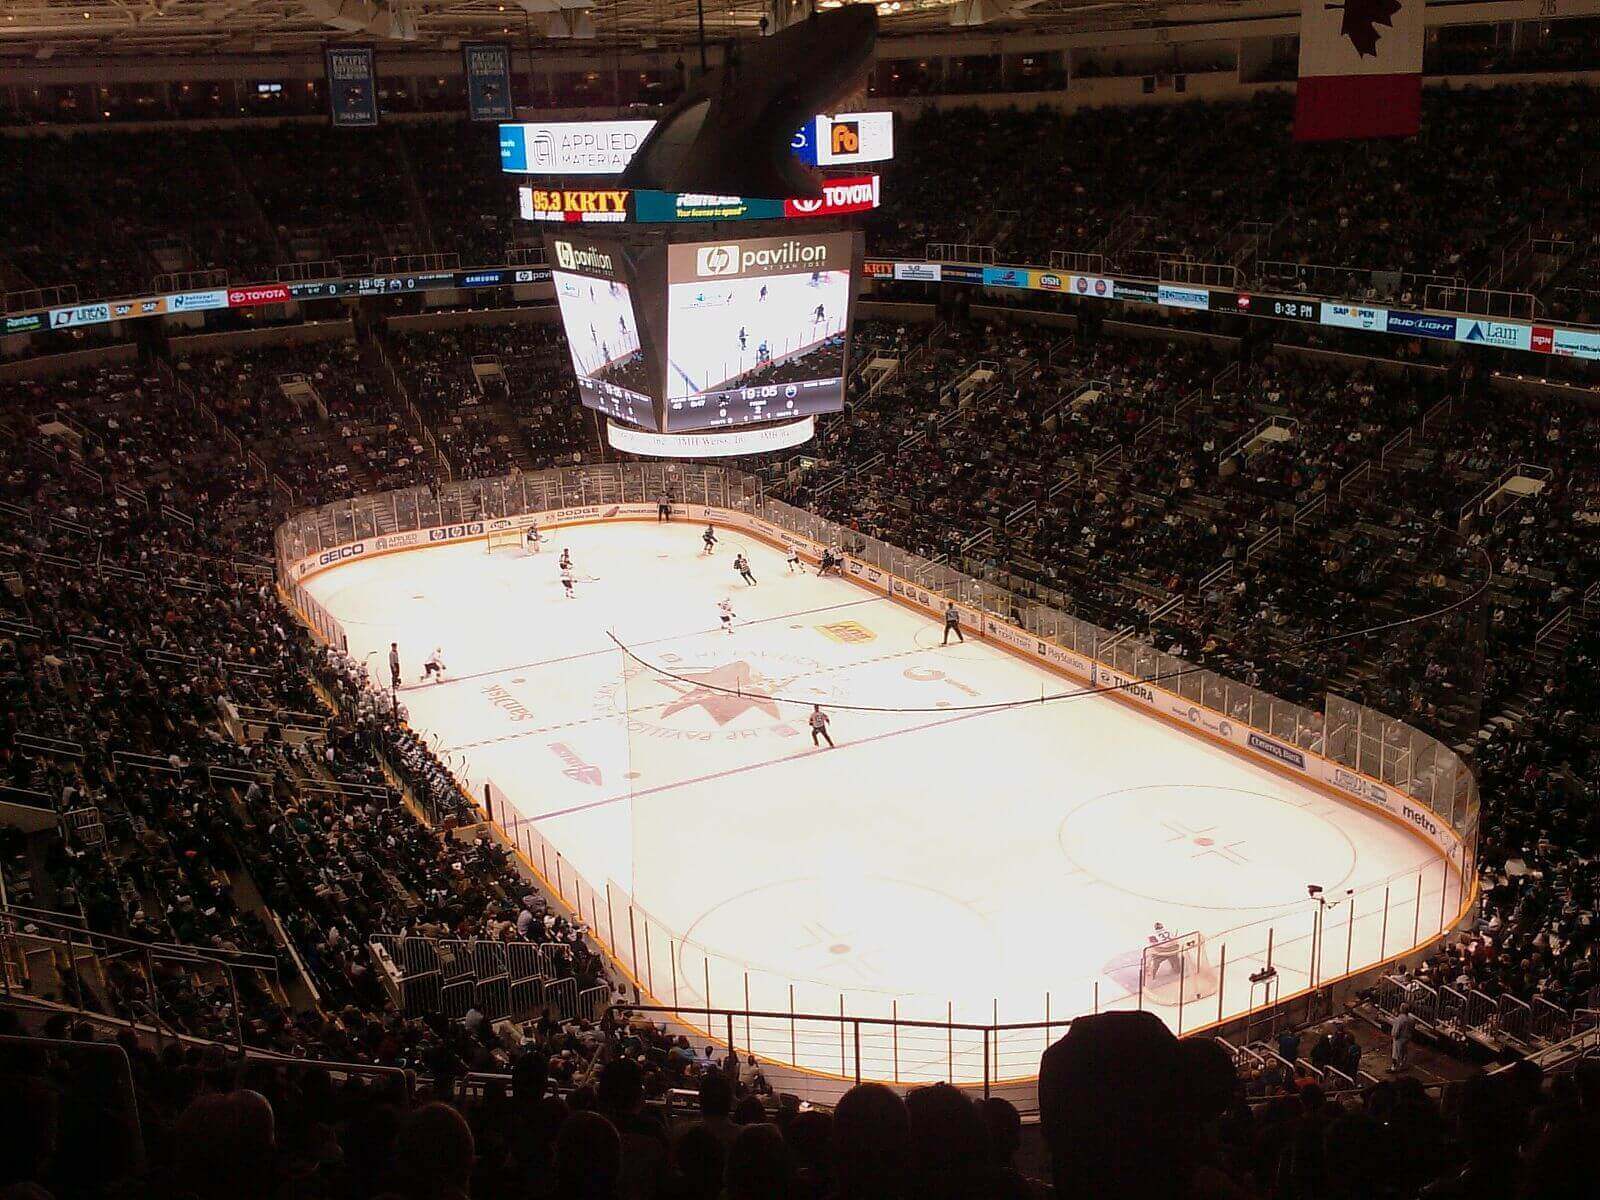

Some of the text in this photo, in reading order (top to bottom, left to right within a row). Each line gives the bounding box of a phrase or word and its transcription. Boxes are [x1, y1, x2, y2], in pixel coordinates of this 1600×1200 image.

[333, 55, 367, 65] PACIFIC
[561, 133, 638, 150] APPLIED
[533, 190, 629, 212] 95.3 KRTY
[823, 184, 873, 207] TOYOTA
[573, 246, 614, 271] pavilion
[742, 241, 827, 273] pavilion
[863, 263, 894, 273] KRTY
[465, 275, 500, 283] SAMSUNG
[246, 290, 286, 301] TOYOTA
[1274, 302, 1313, 318] 8:32 PM
[1333, 307, 1349, 315] SAP
[1388, 317, 1413, 328] BUD
[1417, 319, 1455, 332] LIGHT
[1487, 321, 1516, 340] Lam
[557, 508, 599, 517] DODGE
[319, 543, 364, 566] GEICO
[1113, 675, 1154, 703] TUNDRA
[1282, 751, 1303, 764] Bank
[1403, 804, 1436, 835] metro
